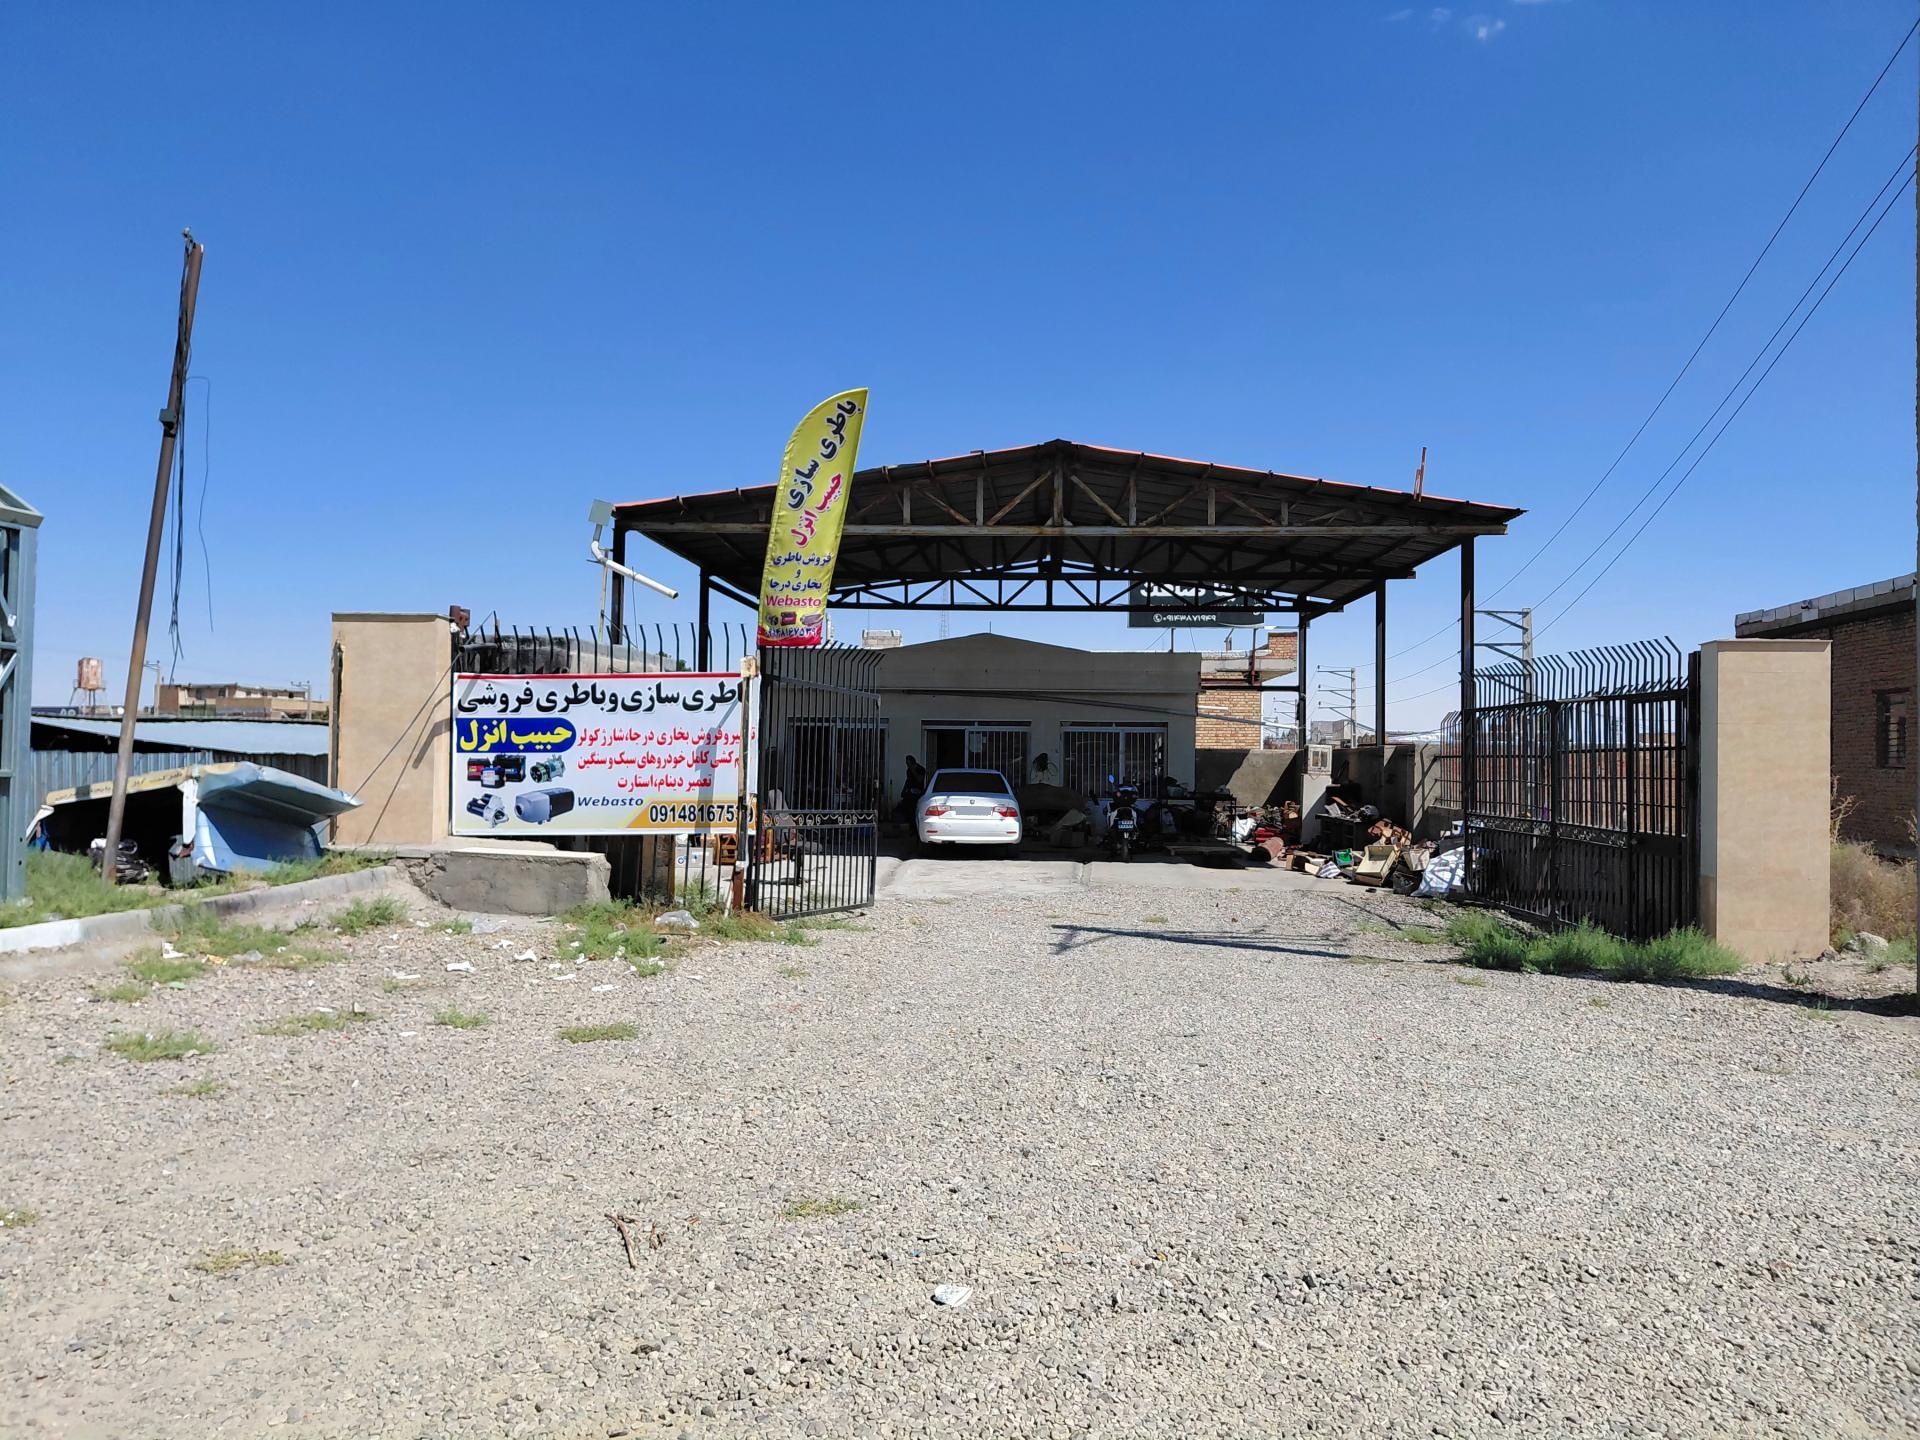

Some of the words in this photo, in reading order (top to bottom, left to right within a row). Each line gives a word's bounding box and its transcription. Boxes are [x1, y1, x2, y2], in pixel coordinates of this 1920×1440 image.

[821, 401, 861, 459] باطری
[788, 460, 819, 509] سازی
[815, 474, 842, 511] حبیب
[791, 510, 817, 546] انزل
[773, 552, 801, 566] باطری
[802, 552, 832, 566] فروش
[795, 569, 801, 578] و
[792, 579, 821, 592] بخاری
[766, 595, 821, 607] Webasto
[457, 681, 534, 712] فروشی
[621, 681, 680, 712] سازی
[682, 680, 743, 712] اطری
[460, 719, 507, 751] انزل
[511, 726, 573, 750] حبیب
[577, 728, 600, 746] کولر
[657, 727, 689, 745] بخاری
[578, 751, 607, 770] سنگین
[614, 750, 636, 768] سبک
[637, 750, 685, 769] خودروهای
[687, 750, 709, 768] کامل
[710, 750, 733, 768] کشی
[686, 773, 712, 791] تعمیر
[578, 796, 644, 807] Webasto
[650, 804, 754, 822] 091481675
